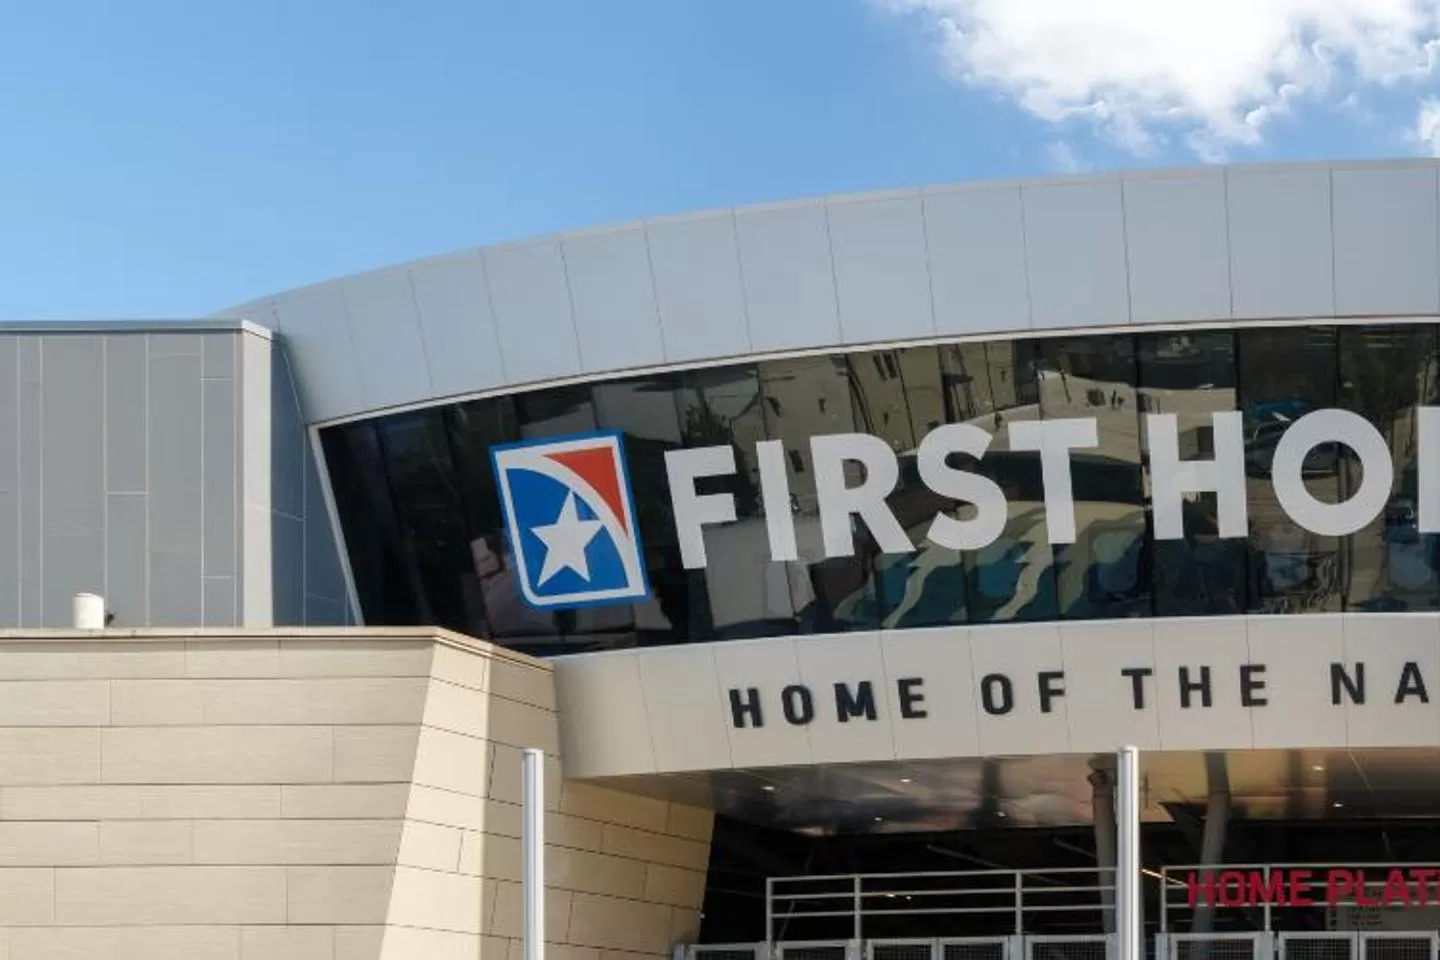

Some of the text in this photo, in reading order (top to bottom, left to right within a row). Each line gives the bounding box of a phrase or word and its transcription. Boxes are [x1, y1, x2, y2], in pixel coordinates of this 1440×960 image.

[664, 416, 1099, 570] FIRST
[728, 676, 928, 729] HOME
[979, 672, 1067, 715] OF
[1120, 663, 1268, 709] THE
[1186, 869, 1314, 908] HOME
